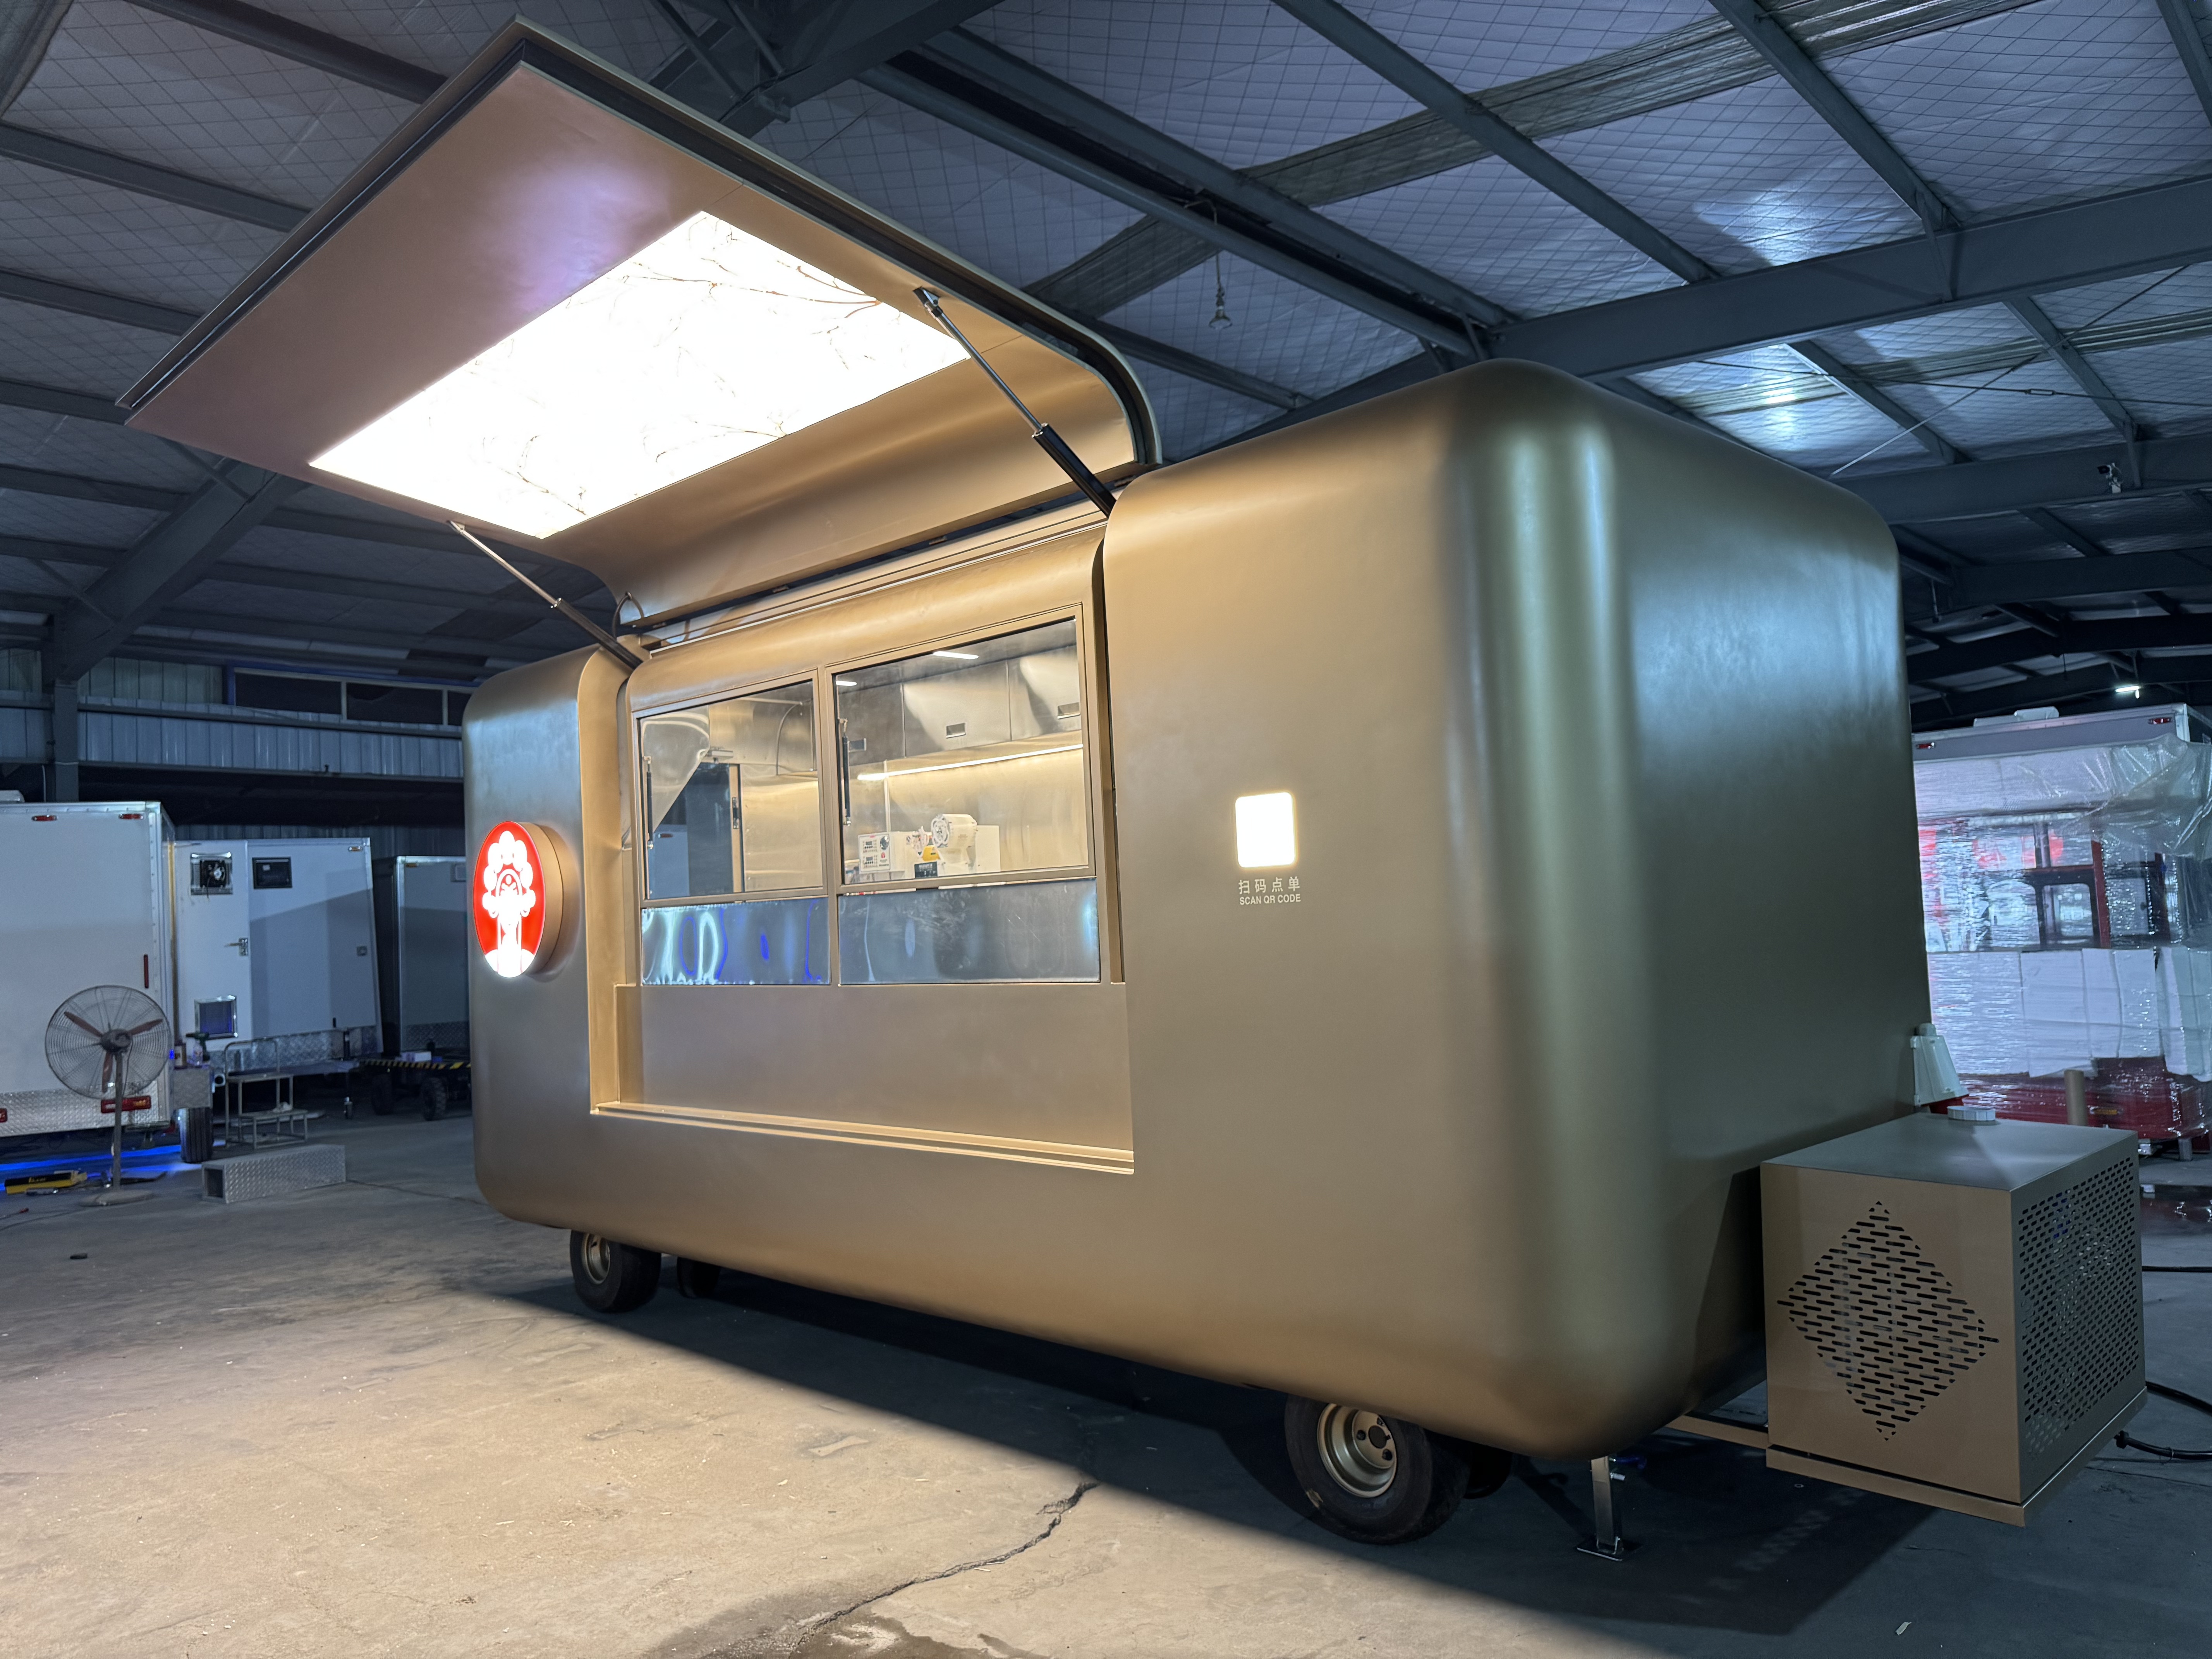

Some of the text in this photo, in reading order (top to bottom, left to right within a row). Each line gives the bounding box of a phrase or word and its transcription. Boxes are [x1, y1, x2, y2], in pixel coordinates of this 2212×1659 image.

[1238, 876, 1300, 894] 扫码点单
[1240, 894, 1301, 905] SCAN QR CODE
